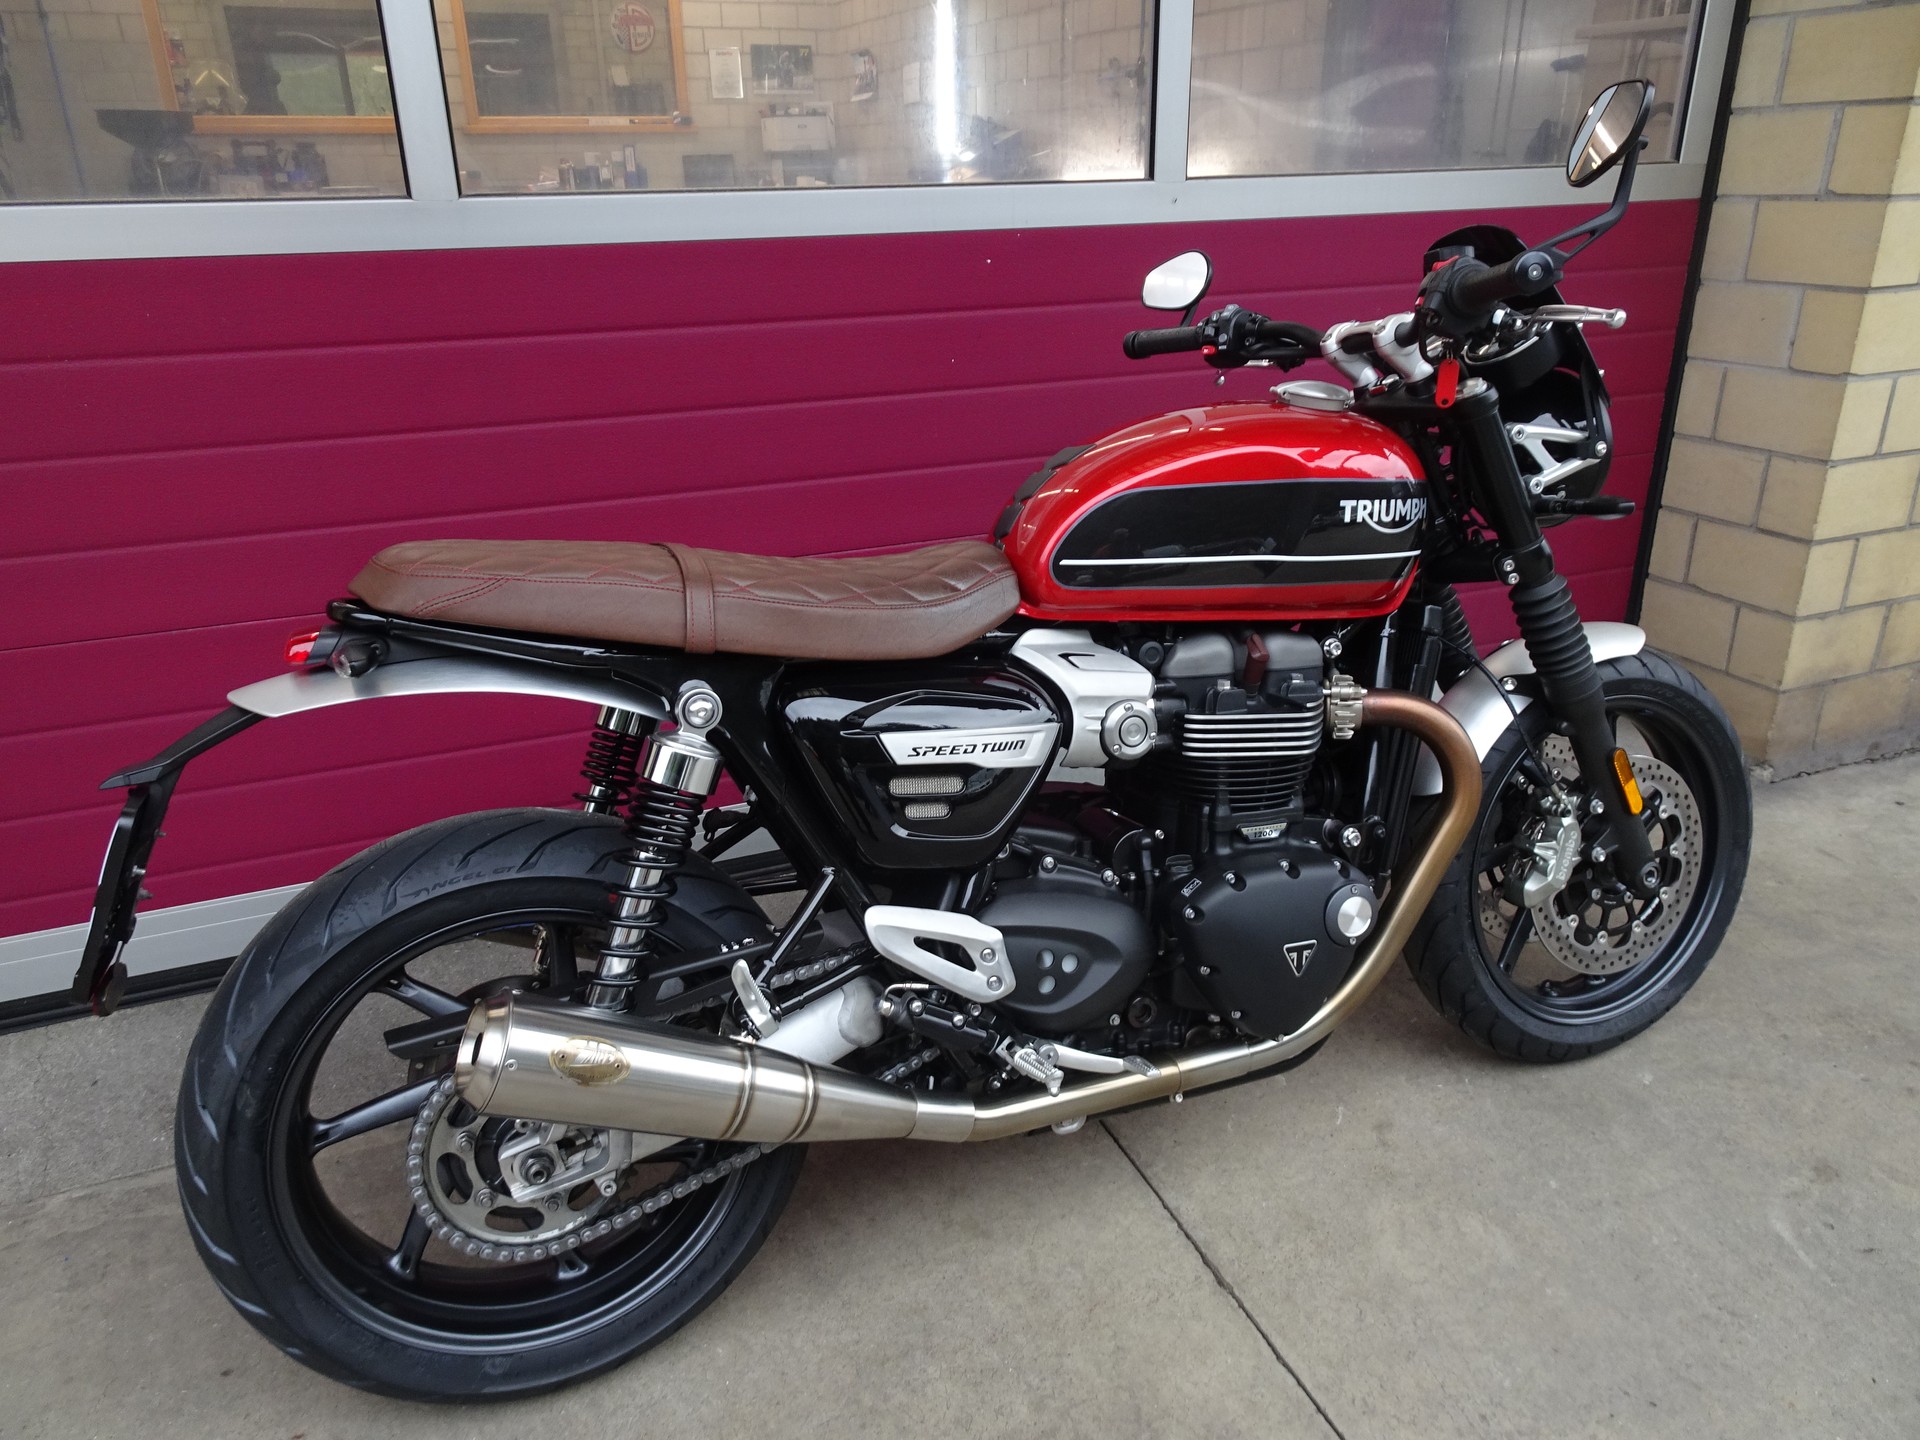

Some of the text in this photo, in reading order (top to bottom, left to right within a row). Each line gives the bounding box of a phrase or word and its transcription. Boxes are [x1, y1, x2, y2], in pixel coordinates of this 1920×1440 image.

[1340, 498, 1427, 533] TRIUMPH
[907, 739, 1026, 758] SPEED TWIN
[1254, 829, 1274, 838] 1200
[1556, 830, 1578, 881] brembo
